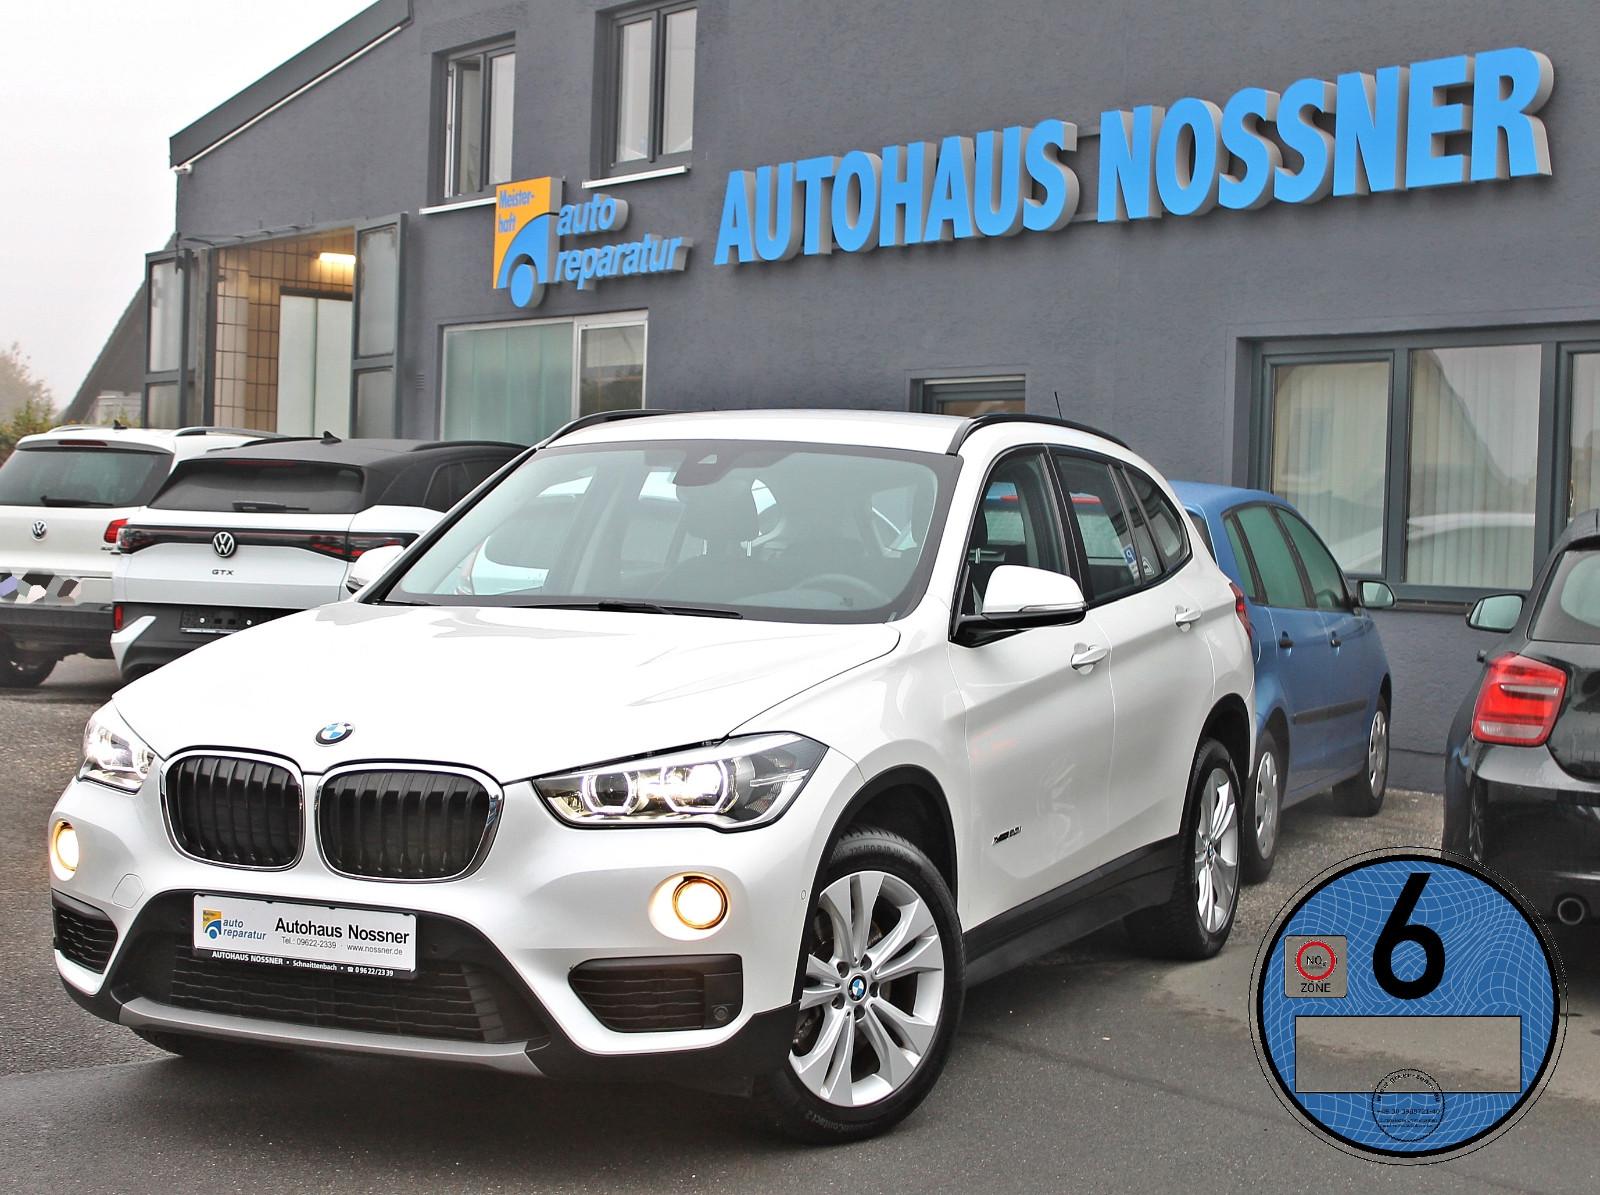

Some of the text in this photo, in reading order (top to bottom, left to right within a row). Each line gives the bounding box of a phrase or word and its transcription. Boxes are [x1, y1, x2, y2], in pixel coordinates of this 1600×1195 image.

[714, 47, 1553, 265] AUTOHAUS NOSSNER
[556, 193, 618, 236] auto
[554, 233, 688, 290] reparatur
[223, 919, 244, 928] auto
[223, 929, 267, 940] reparatur
[275, 917, 410, 944] Autohaus Nossner
[296, 937, 337, 949] 09622-2339
[346, 944, 403, 955] www.nossner.de
[211, 951, 249, 962] AUTOHAUS
[250, 955, 284, 965] NOSSNER
[292, 959, 337, 971] Schnaittenbach
